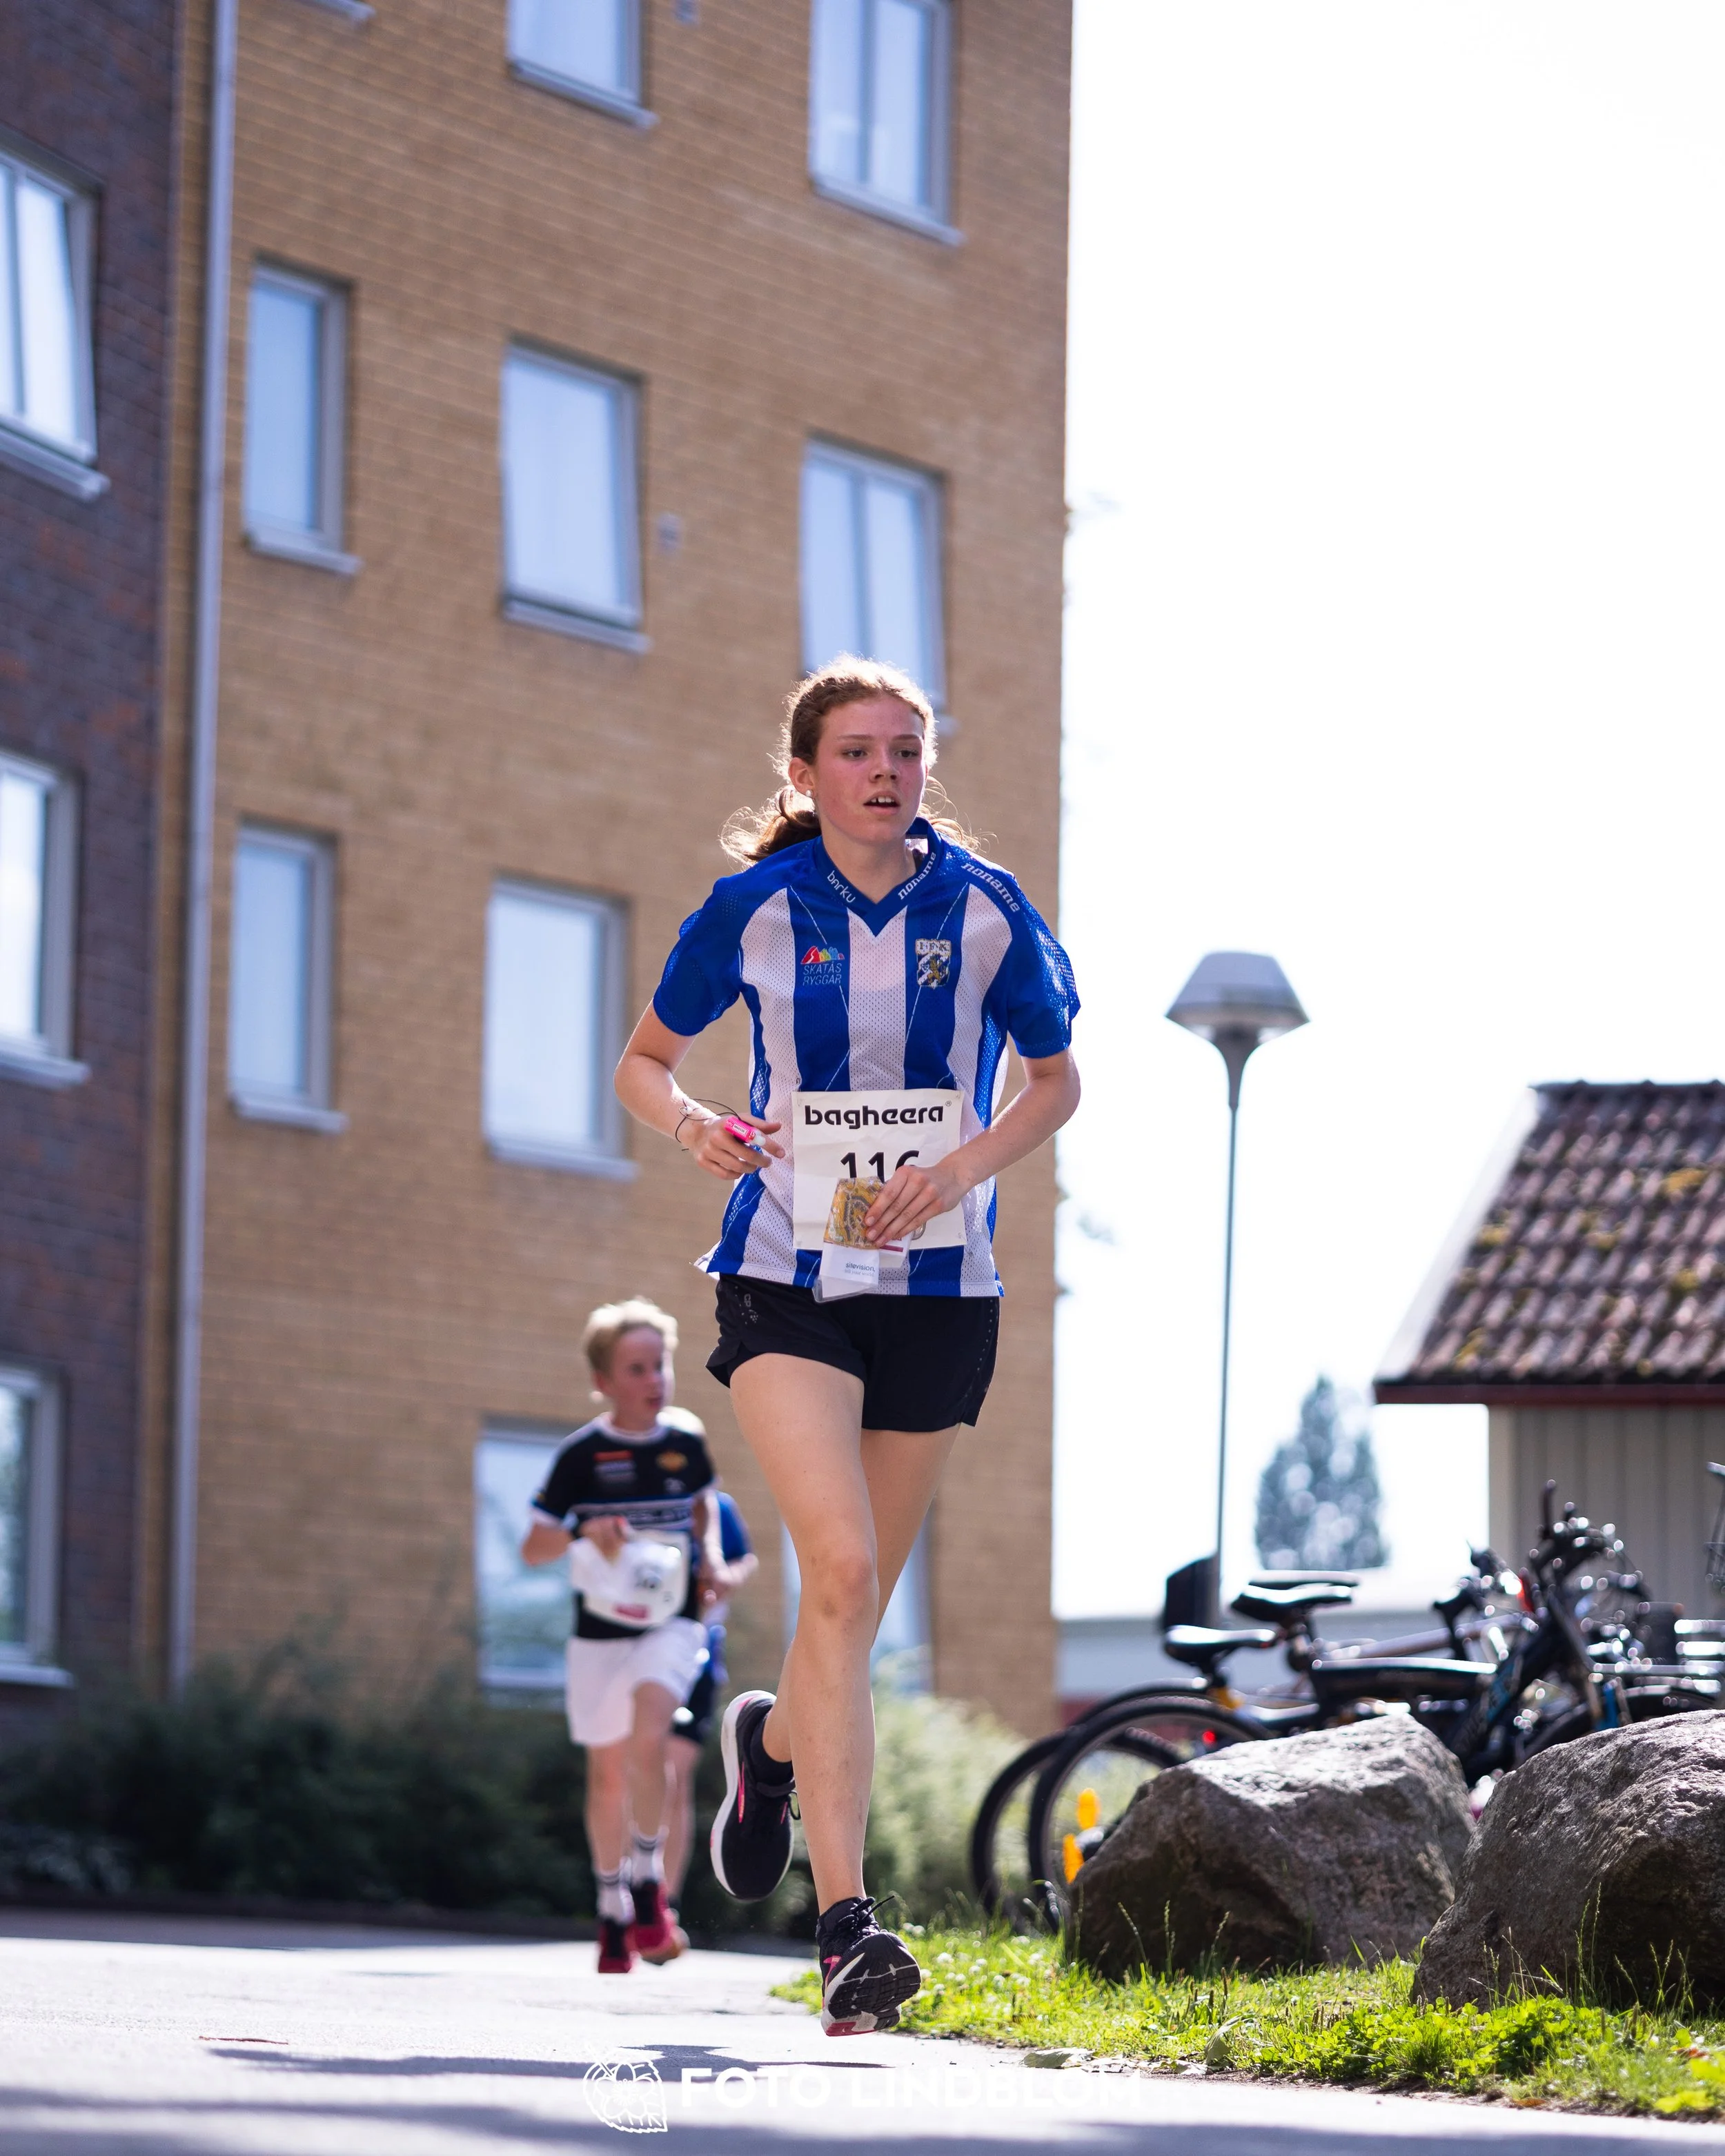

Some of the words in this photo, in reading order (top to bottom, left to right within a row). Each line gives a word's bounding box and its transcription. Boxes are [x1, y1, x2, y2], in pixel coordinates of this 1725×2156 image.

[898, 852, 936, 900] noname
[960, 862, 1021, 912] noname
[802, 973, 842, 987] RYGGAR
[805, 1105, 944, 1129] bagheera
